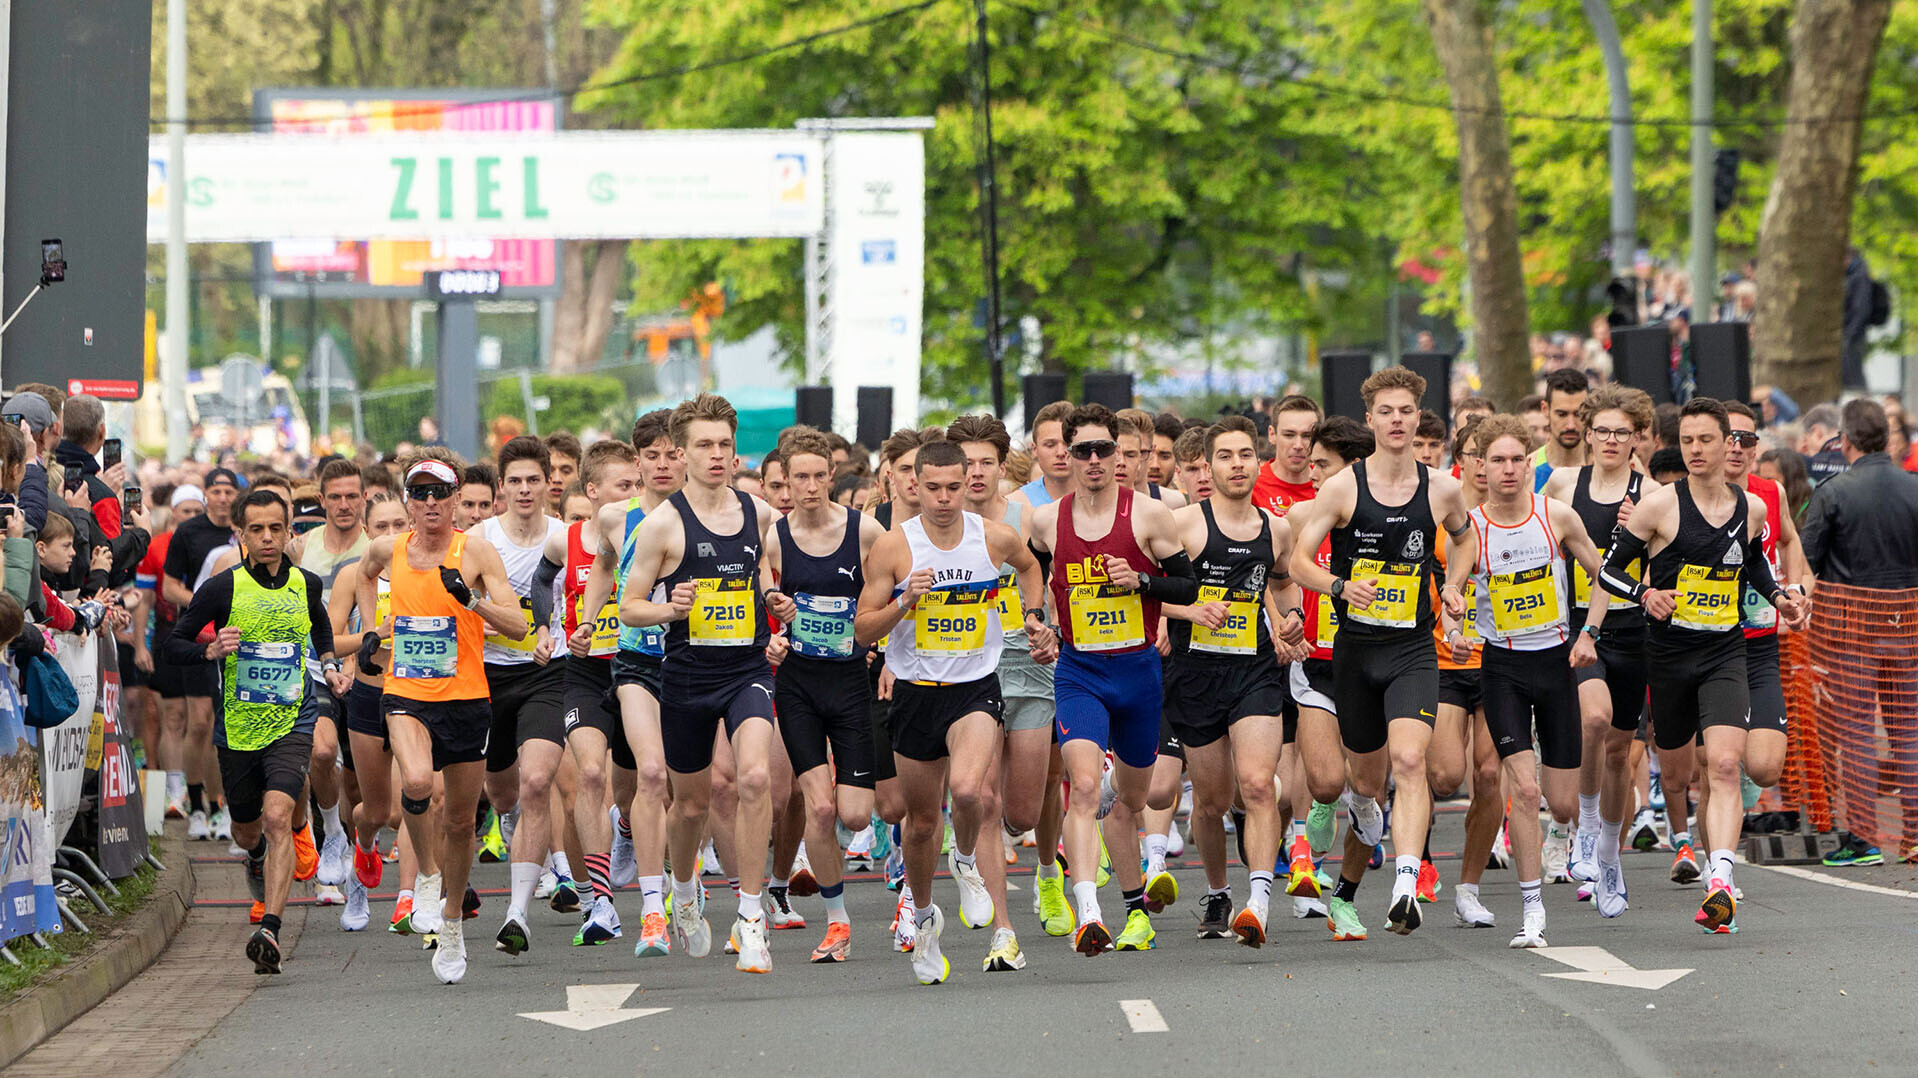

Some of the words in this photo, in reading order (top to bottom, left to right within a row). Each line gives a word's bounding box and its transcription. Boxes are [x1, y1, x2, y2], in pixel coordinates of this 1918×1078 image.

[390, 157, 549, 219] ZIEL
[716, 563, 744, 572] VIACTIV
[1503, 592, 1546, 613] 7231
[1686, 591, 1731, 608] 7264
[703, 605, 746, 621] 7216
[1086, 609, 1127, 626] 7211
[800, 618, 845, 635] 5589
[927, 617, 977, 633] 5908
[939, 635, 962, 643] Tristan
[403, 640, 448, 655] 5733
[247, 666, 292, 681] 6677
